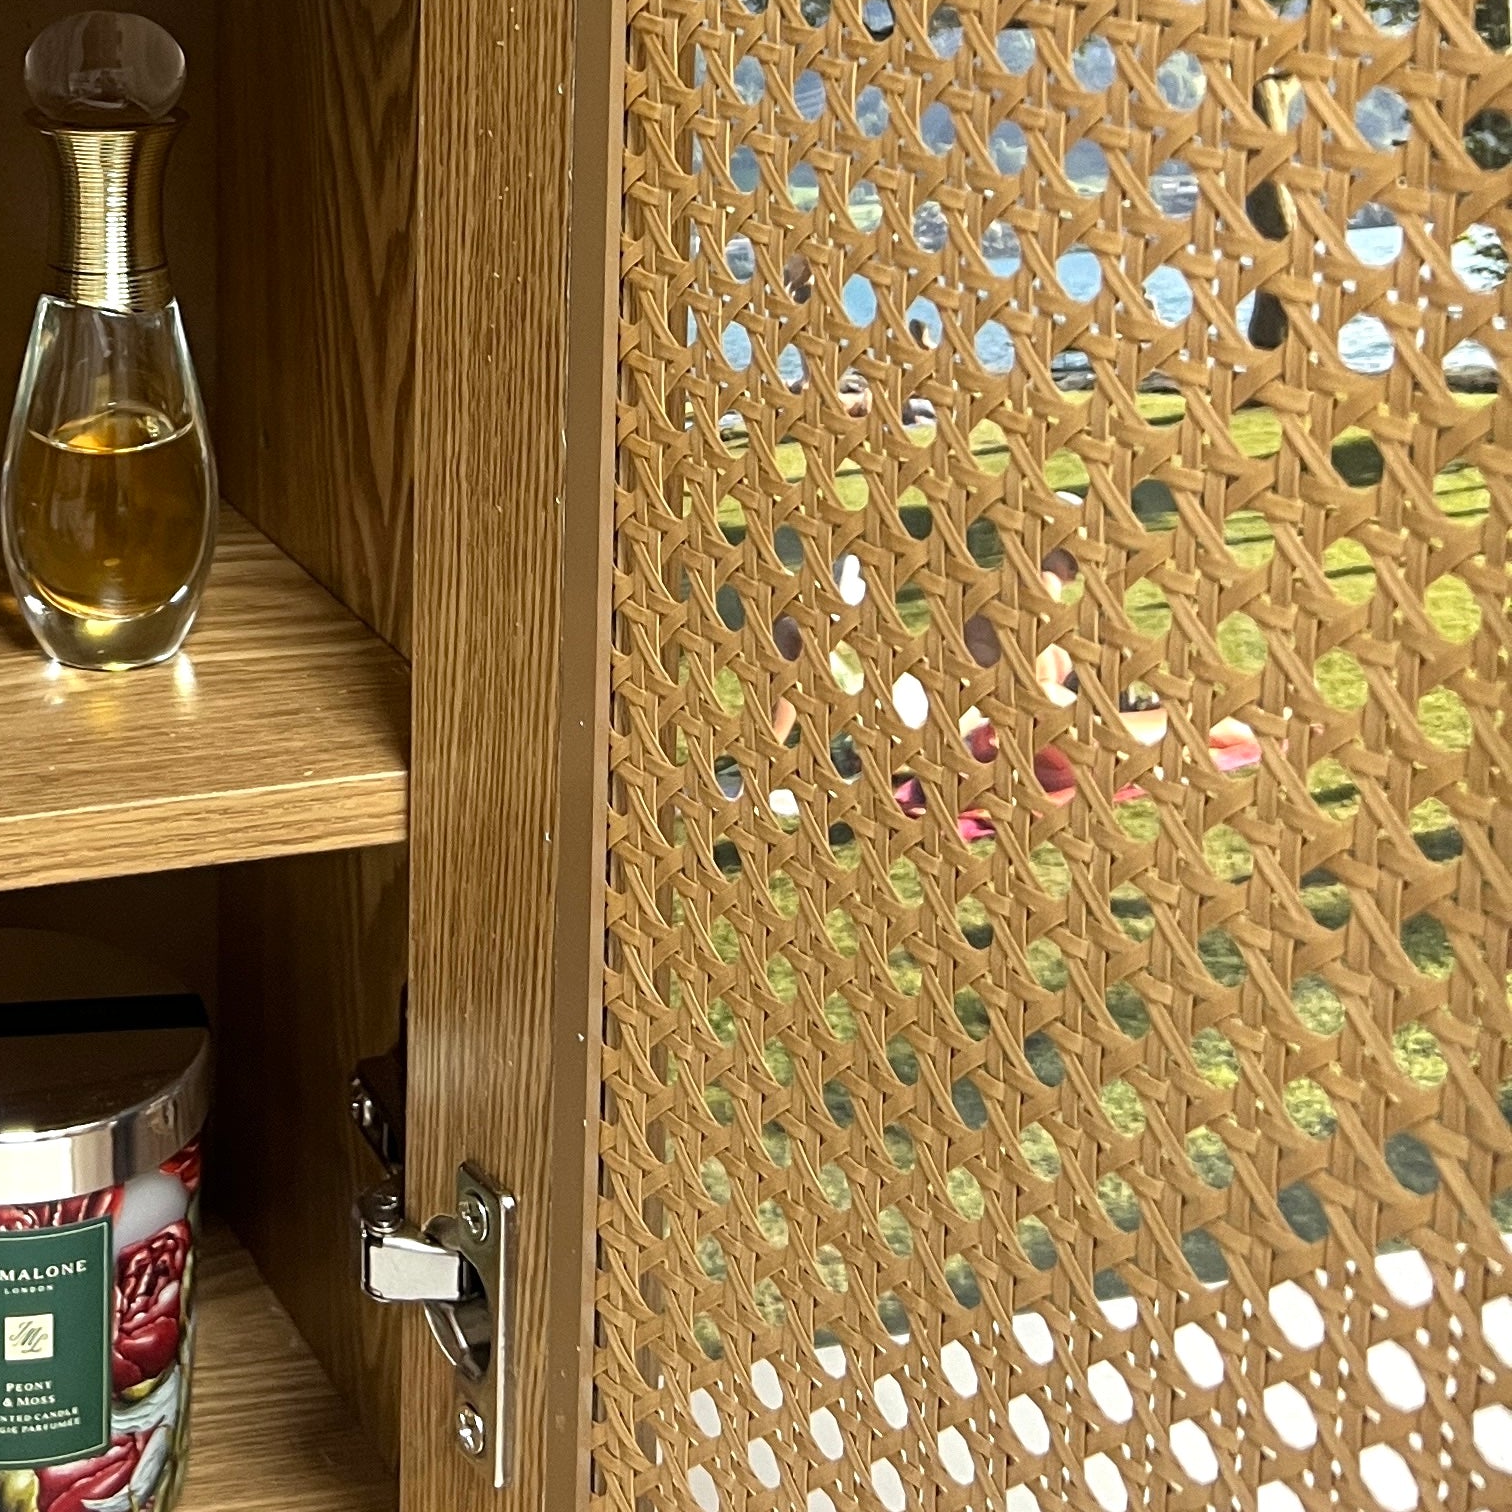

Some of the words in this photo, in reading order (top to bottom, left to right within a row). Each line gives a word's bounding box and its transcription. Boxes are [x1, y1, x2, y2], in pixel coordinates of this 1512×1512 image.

[0, 1259, 87, 1282] MALONE
[4, 1284, 54, 1295] LONDON
[5, 1380, 52, 1392] PEONY
[2, 1397, 14, 1408] &
[16, 1394, 56, 1407] MOSS
[33, 1406, 79, 1421] CANDLE
